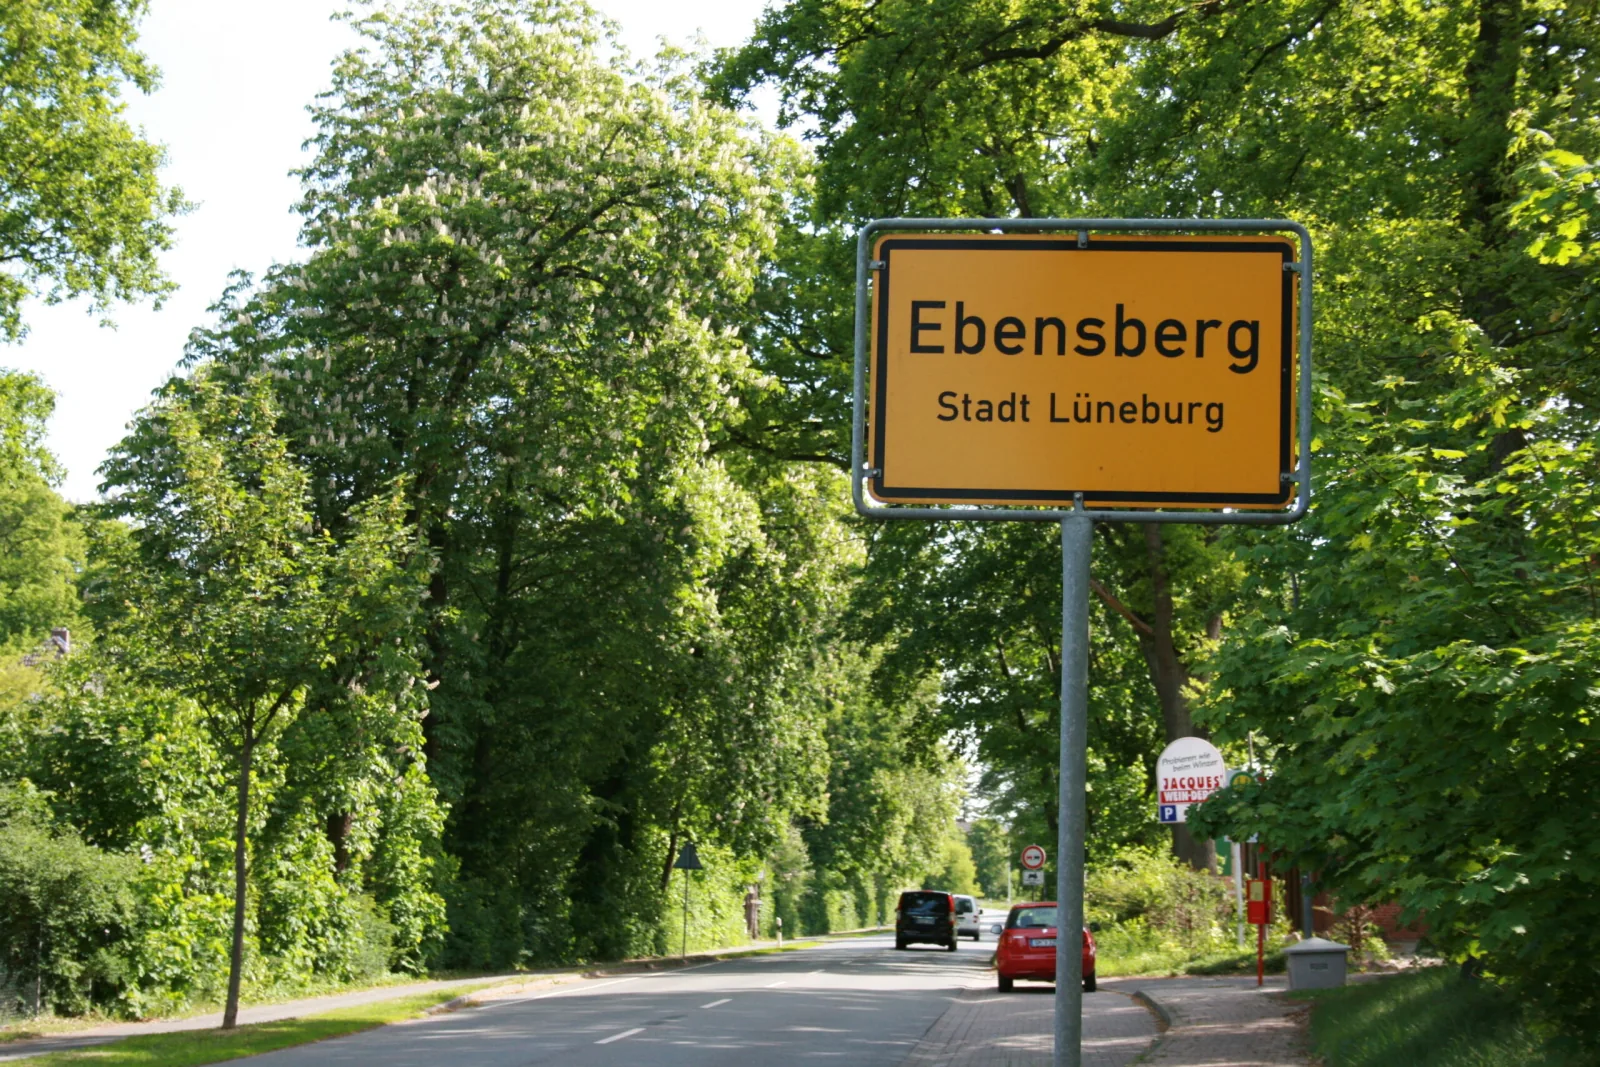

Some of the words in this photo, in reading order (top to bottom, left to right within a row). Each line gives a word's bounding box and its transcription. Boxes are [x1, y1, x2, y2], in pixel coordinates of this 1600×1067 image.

[909, 300, 1260, 375] Ebensberg
[936, 391, 1031, 423] Stadt
[1049, 392, 1225, 433] Lüneburg
